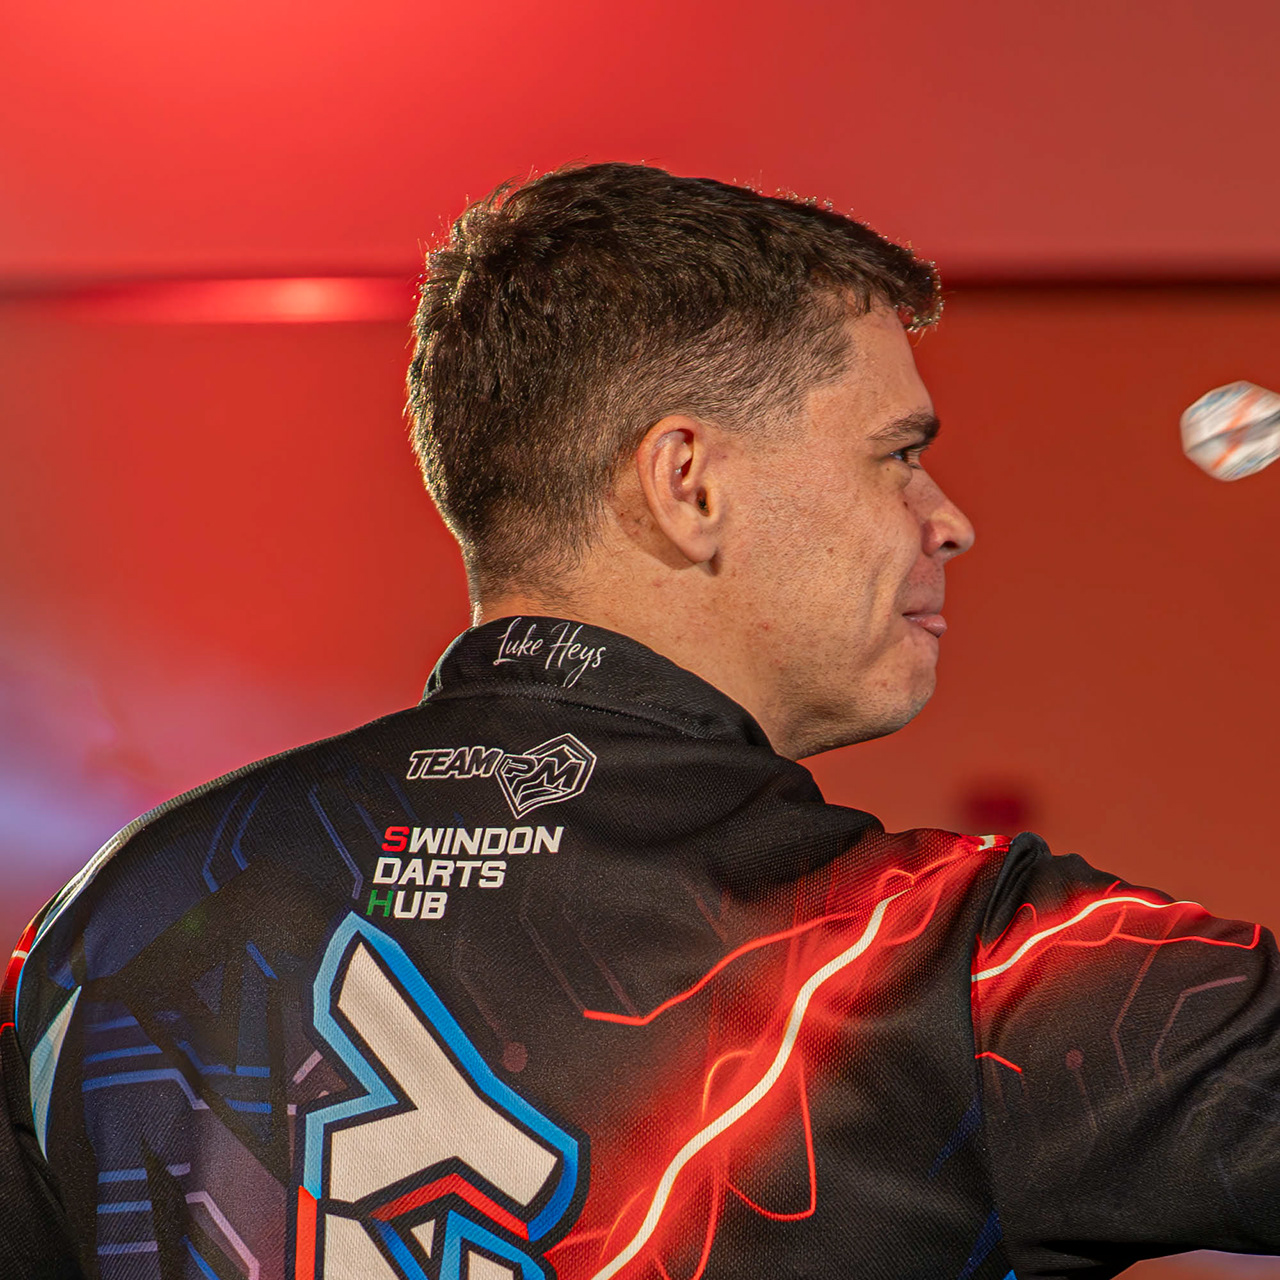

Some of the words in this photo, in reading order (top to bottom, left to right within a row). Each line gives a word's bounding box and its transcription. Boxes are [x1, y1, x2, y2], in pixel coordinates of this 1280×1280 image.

[493, 617, 544, 666] Luke
[545, 621, 607, 688] Heys
[406, 745, 504, 779] TEAM
[381, 826, 564, 855] SWINDON
[372, 857, 507, 888] DARTS
[366, 889, 449, 919] HUB
